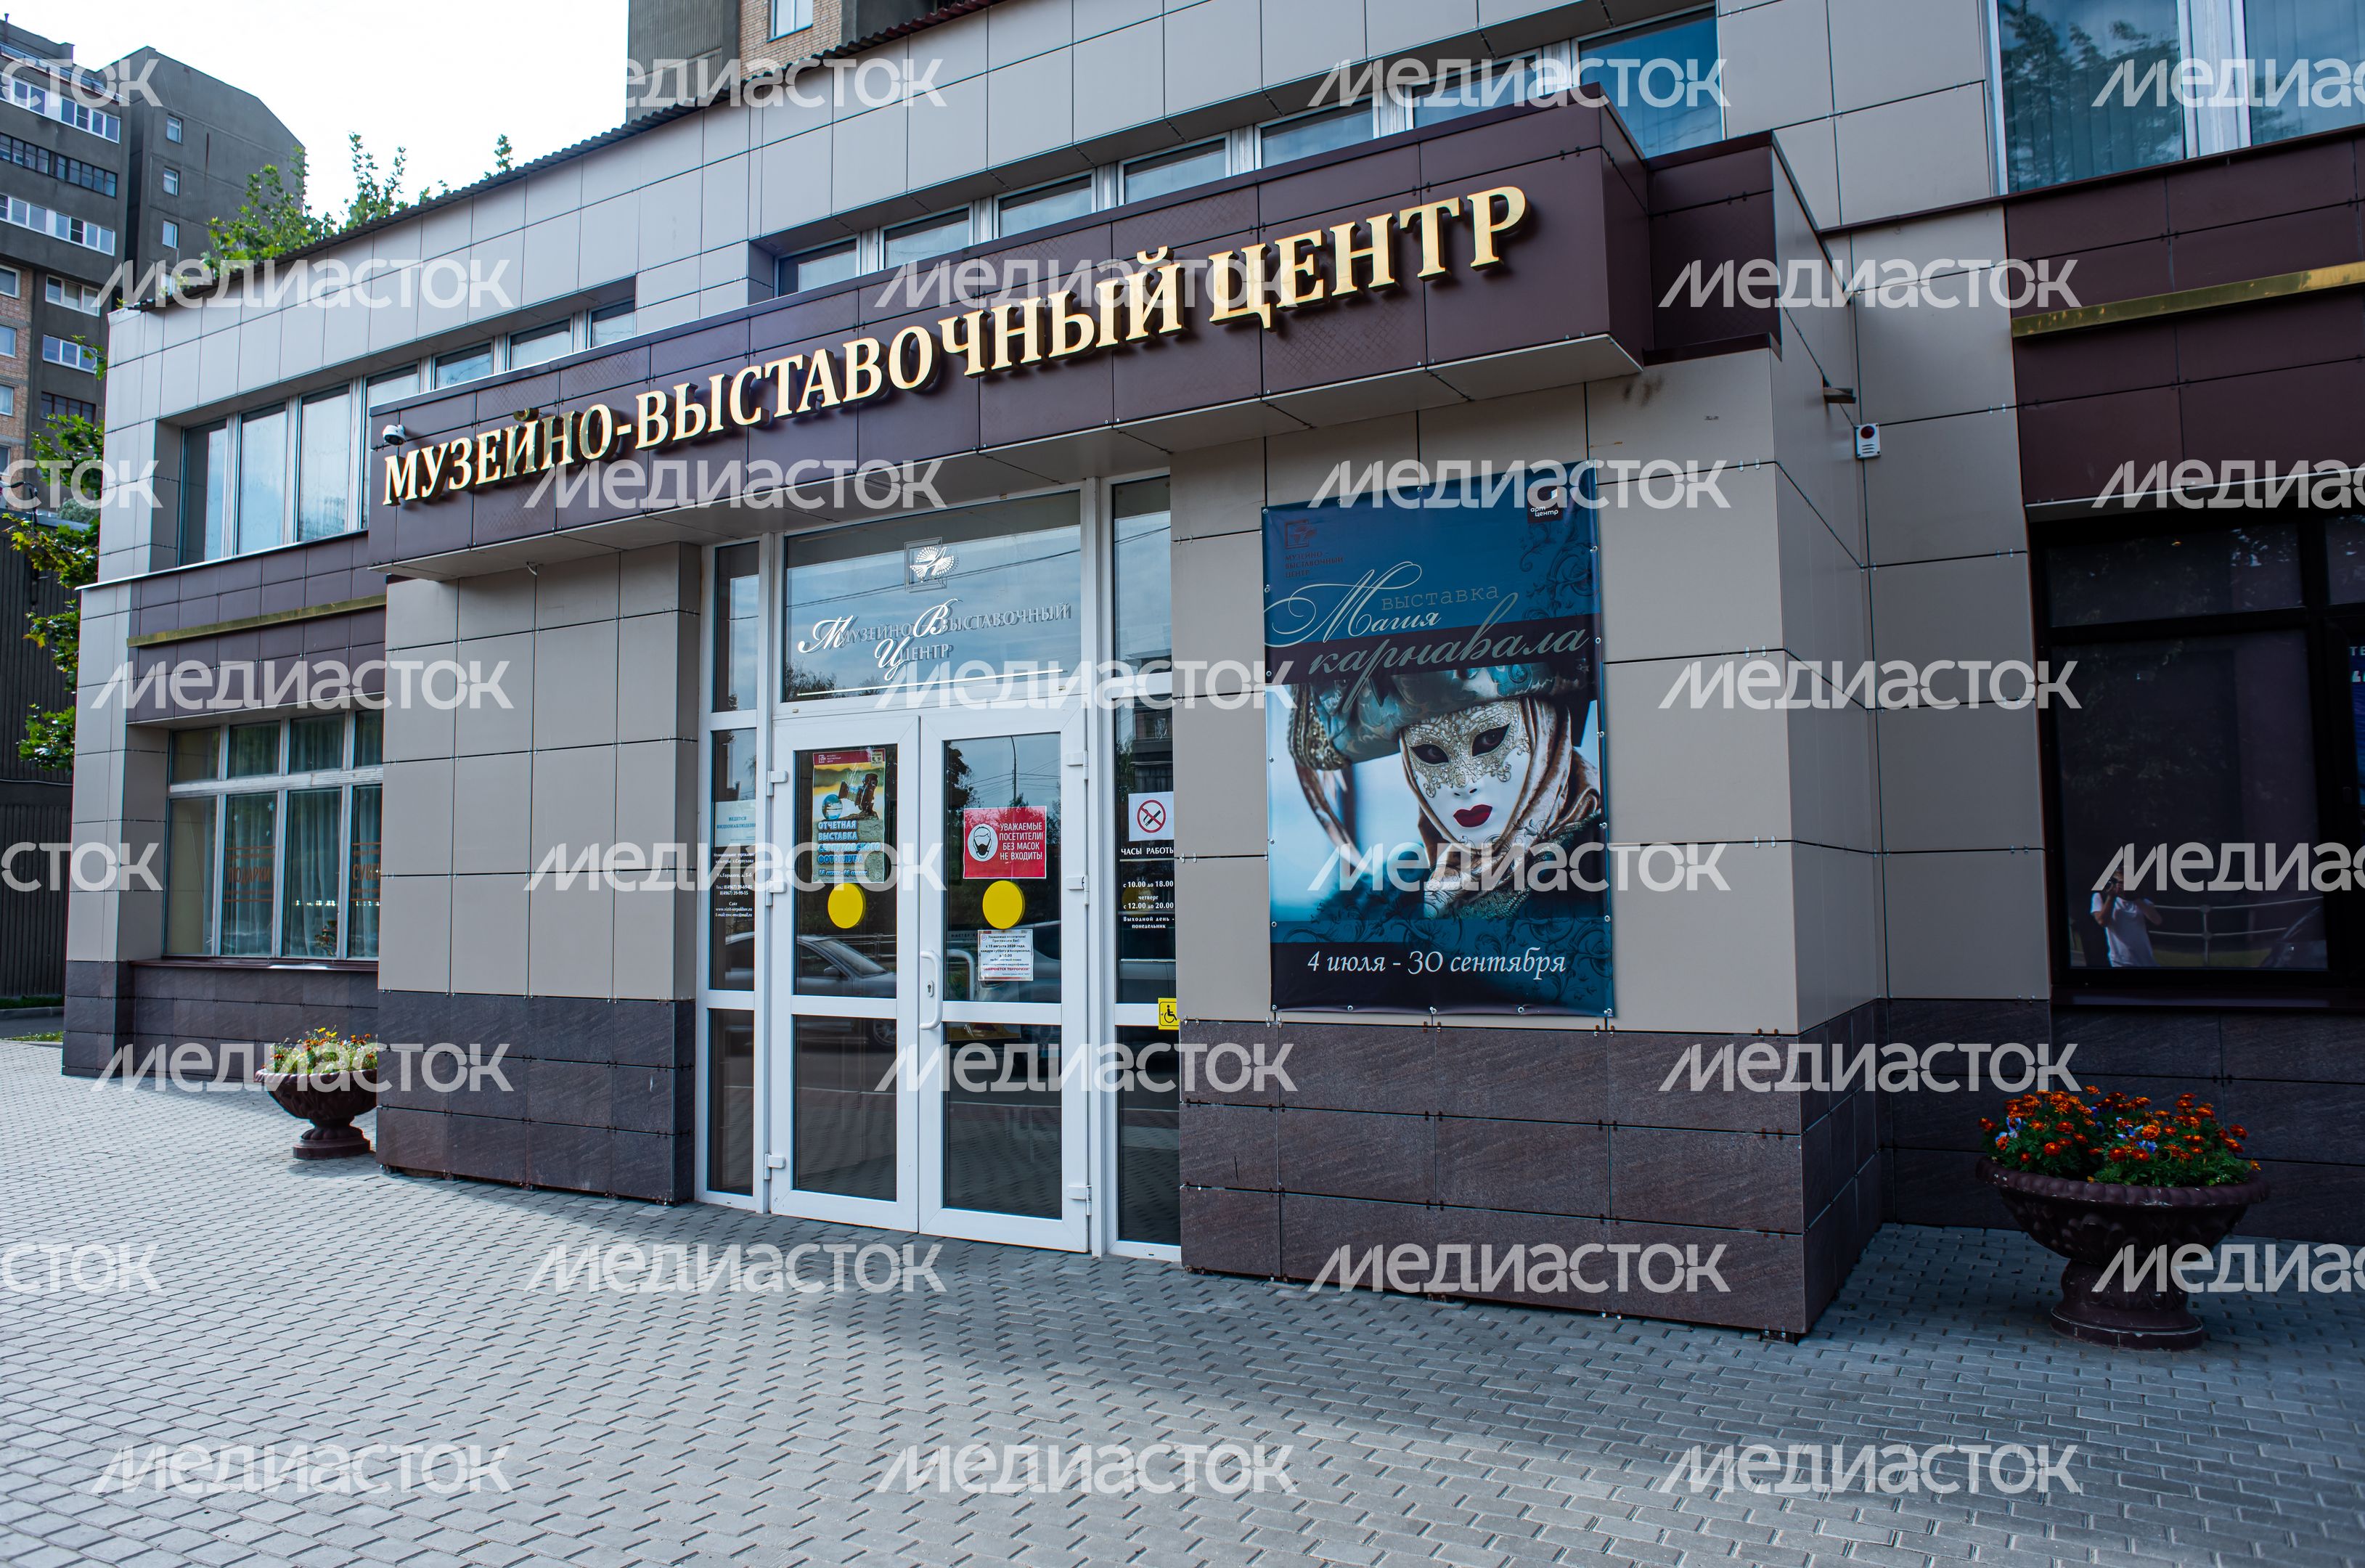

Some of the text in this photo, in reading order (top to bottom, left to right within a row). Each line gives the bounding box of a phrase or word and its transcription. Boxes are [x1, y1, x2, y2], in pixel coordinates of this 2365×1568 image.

[383, 186, 1528, 506] МУЗЕЙНО-ВЫСТАВОЧНЫЙ ЦЕНТР
[1263, 561, 1442, 648] Магия
[1308, 592, 1590, 714] карнавала
[818, 820, 857, 830] ОТЧЕТНАЯ
[1000, 822, 1042, 831] УВАЖАЕМЫЕ
[818, 831, 858, 841] ВЫСТАВКА
[999, 832, 1043, 841] ПОСЕТИТЕЛИ!
[1010, 852, 1042, 861] ВХОДИТЬ!
[1307, 950, 1320, 972] 4
[1326, 955, 1386, 972] июля
[1408, 950, 1444, 975] 30
[1450, 947, 1567, 980] сентября
